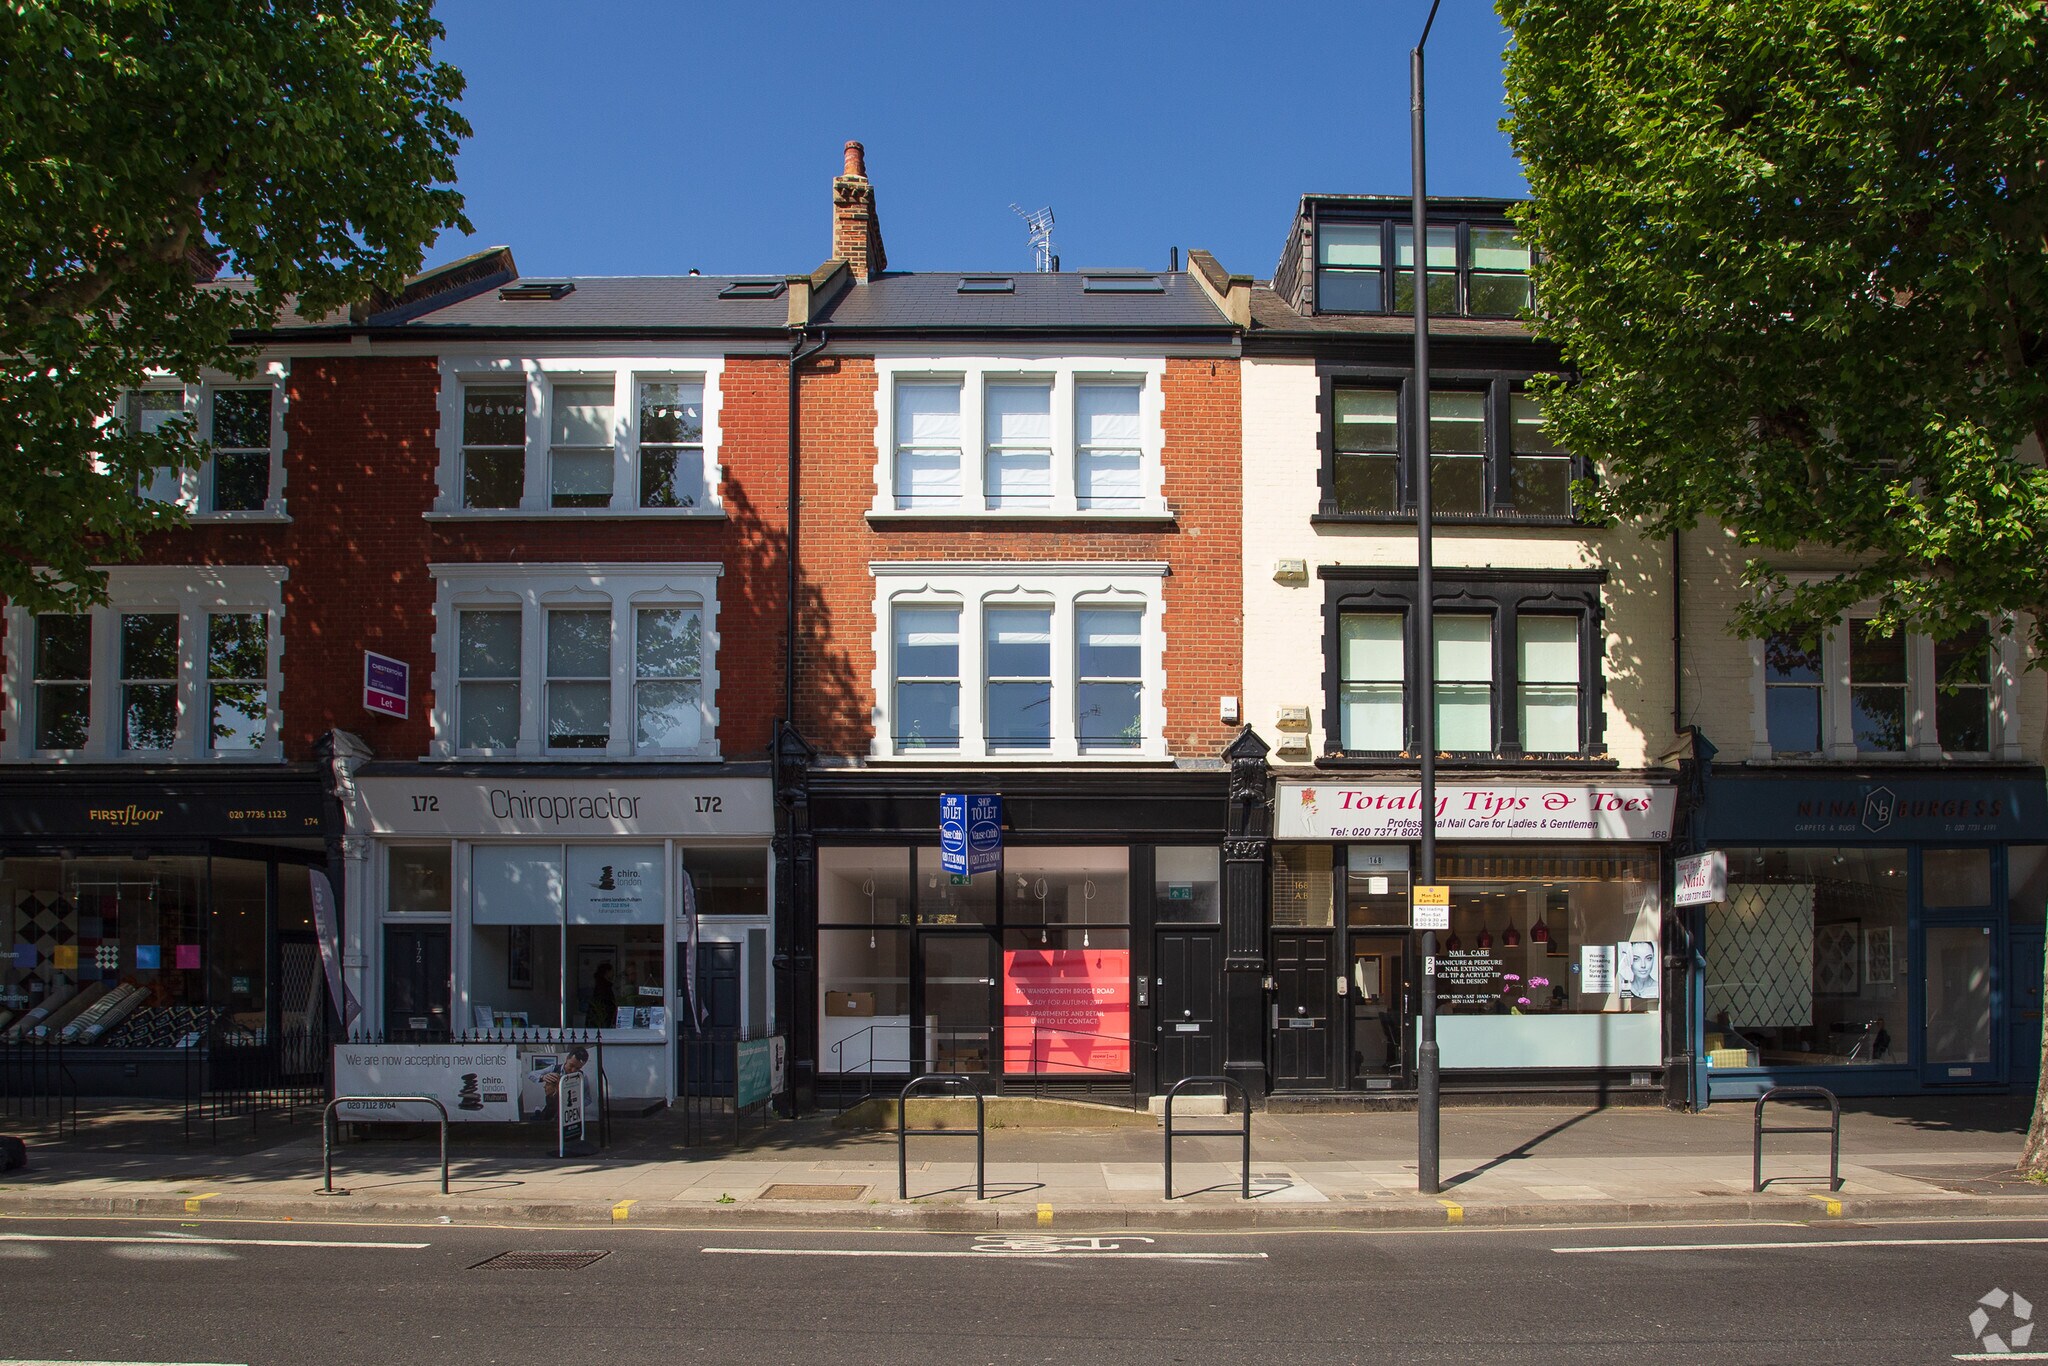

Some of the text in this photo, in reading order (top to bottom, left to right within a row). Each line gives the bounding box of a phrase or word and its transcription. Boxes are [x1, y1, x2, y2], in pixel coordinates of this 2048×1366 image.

[381, 697, 393, 709] Let
[412, 796, 440, 812] 172
[694, 796, 723, 813] 172
[946, 797, 957, 806] SHOP
[977, 798, 991, 807] SHOP
[1463, 791, 1529, 820] Tips
[1542, 792, 1576, 811] &
[1590, 792, 1652, 812] Toes
[490, 789, 641, 825] Chiropractor
[1797, 800, 2003, 817] NINA BURGESS
[229, 810, 287, 819] 020 7736 1123
[943, 807, 962, 820] TO LET
[971, 806, 998, 821] TO LET
[304, 817, 319, 826] 174
[1387, 818, 1599, 829] Professal Nail Care for Ladies & Gentlemen
[1794, 823, 1826, 832] CARPETS
[1838, 824, 1856, 832] RUGS
[1330, 828, 1349, 837] Tel:
[1352, 828, 1371, 837] 020
[1374, 828, 1398, 837] 7371
[1651, 831, 1668, 839] 168
[617, 869, 641, 878] chiro.
[617, 878, 642, 886] london
[1682, 869, 1705, 889] Nails
[1295, 881, 1309, 889] 168
[1027, 987, 1072, 995] WANDSWORTH
[1073, 987, 1096, 995] BRIDGE
[1096, 987, 1115, 995] ROAD
[345, 1053, 507, 1069] We are now accepting new clients
[482, 1076, 504, 1085] chiro.
[347, 1101, 396, 1110] 020 7112 8764
[565, 1107, 580, 1123] OPEN
